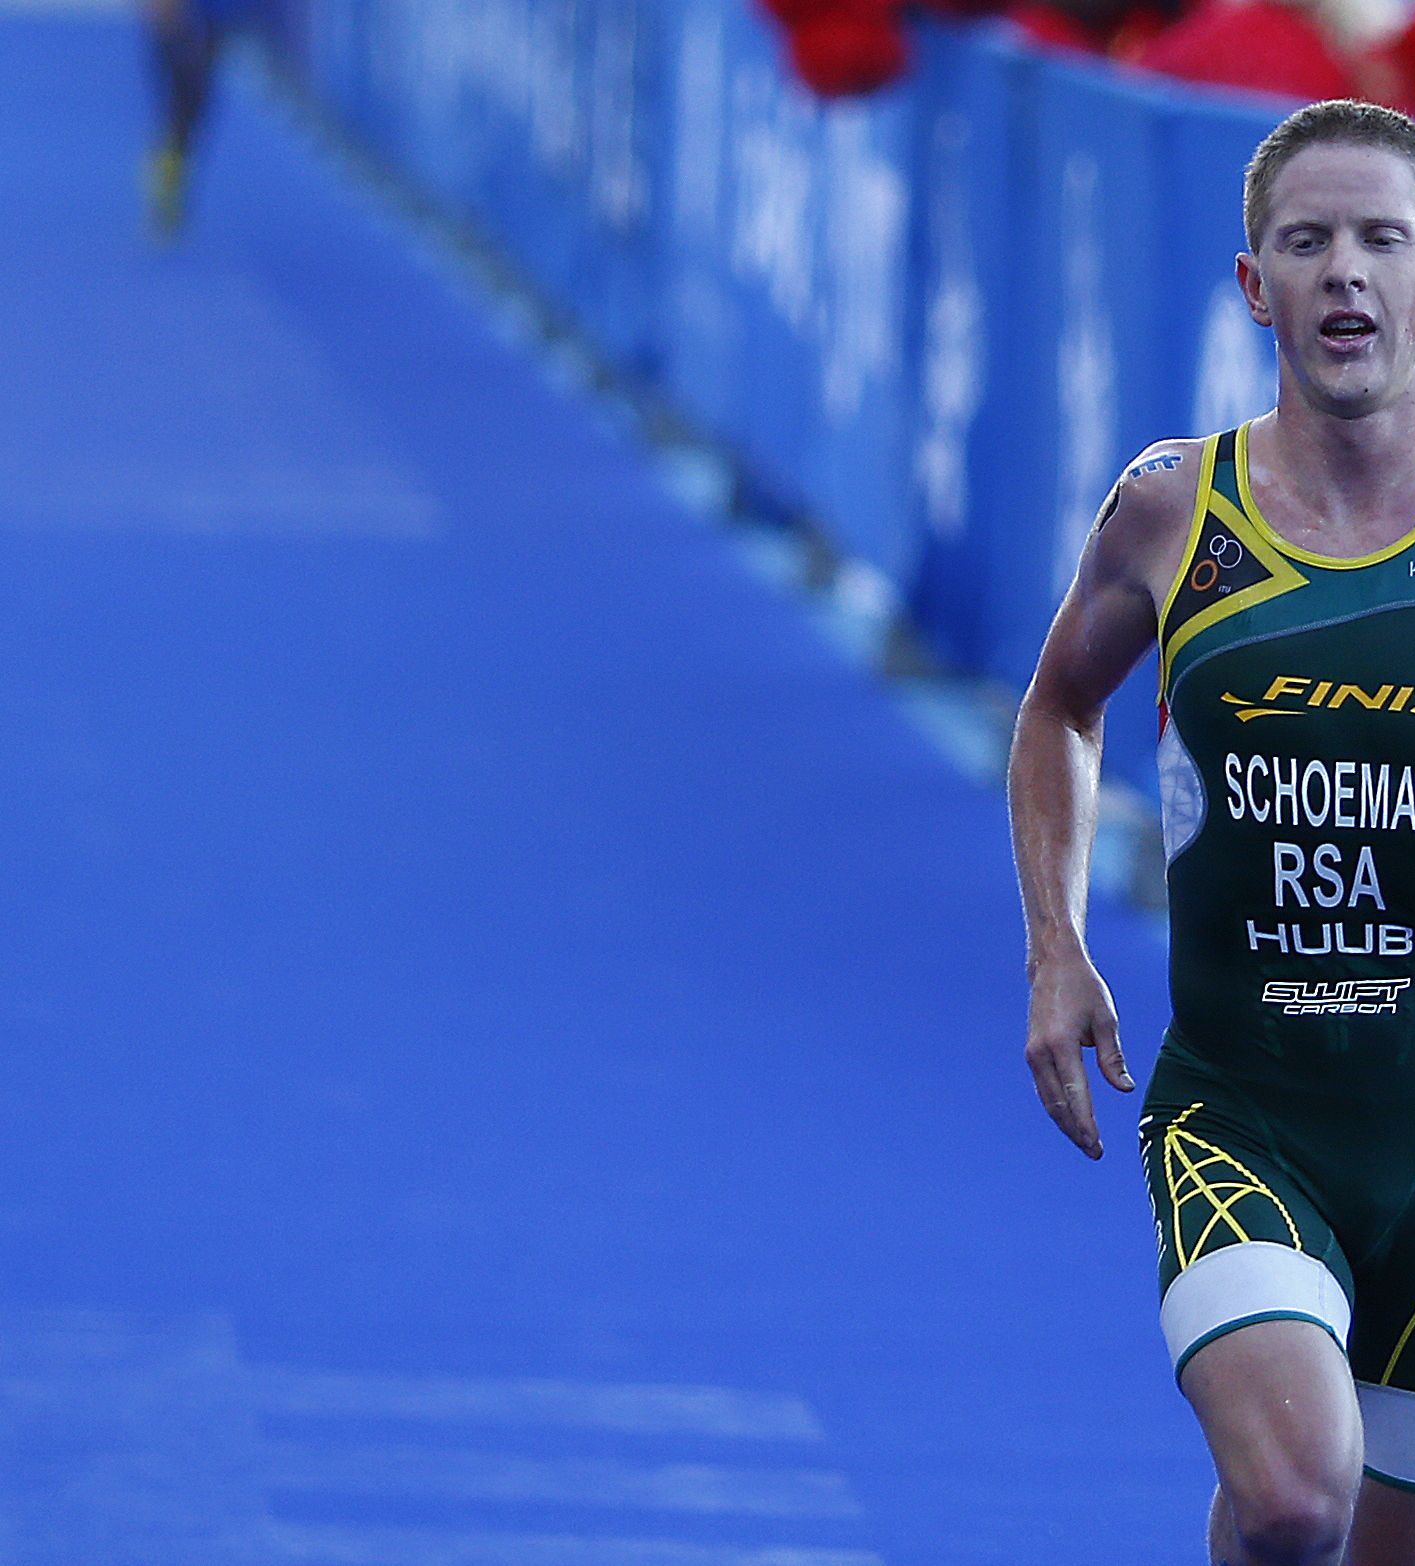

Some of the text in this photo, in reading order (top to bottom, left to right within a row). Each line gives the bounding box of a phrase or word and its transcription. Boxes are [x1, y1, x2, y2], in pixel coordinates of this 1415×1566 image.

[1273, 841, 1386, 911] RSA
[1246, 919, 1414, 956] HUUB
[1261, 977, 1411, 1003] SWIFT
[1283, 1003, 1397, 1015] CARBON
